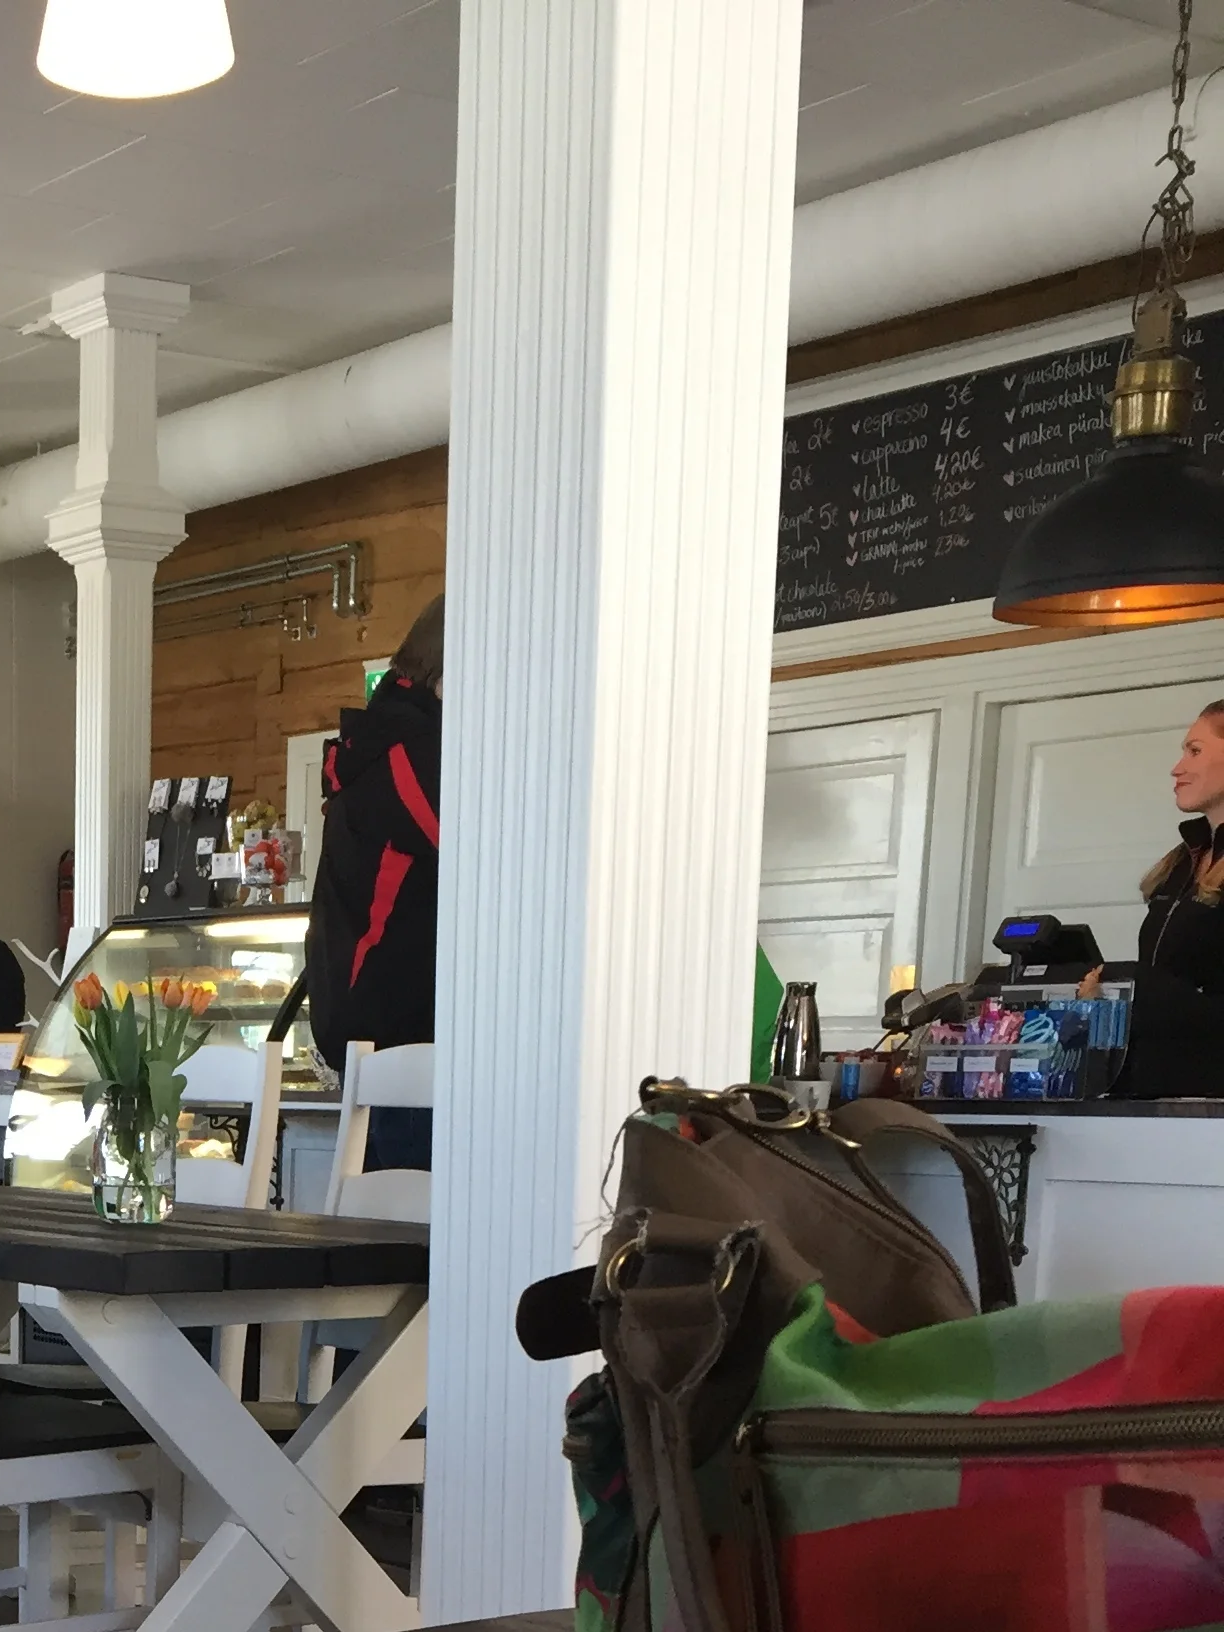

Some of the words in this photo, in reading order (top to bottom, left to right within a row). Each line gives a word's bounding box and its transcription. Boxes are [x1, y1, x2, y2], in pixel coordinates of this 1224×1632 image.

[862, 403, 929, 437] espresso
[945, 376, 976, 411] 3€
[940, 416, 971, 447] 4€
[1018, 423, 1063, 450] makea
